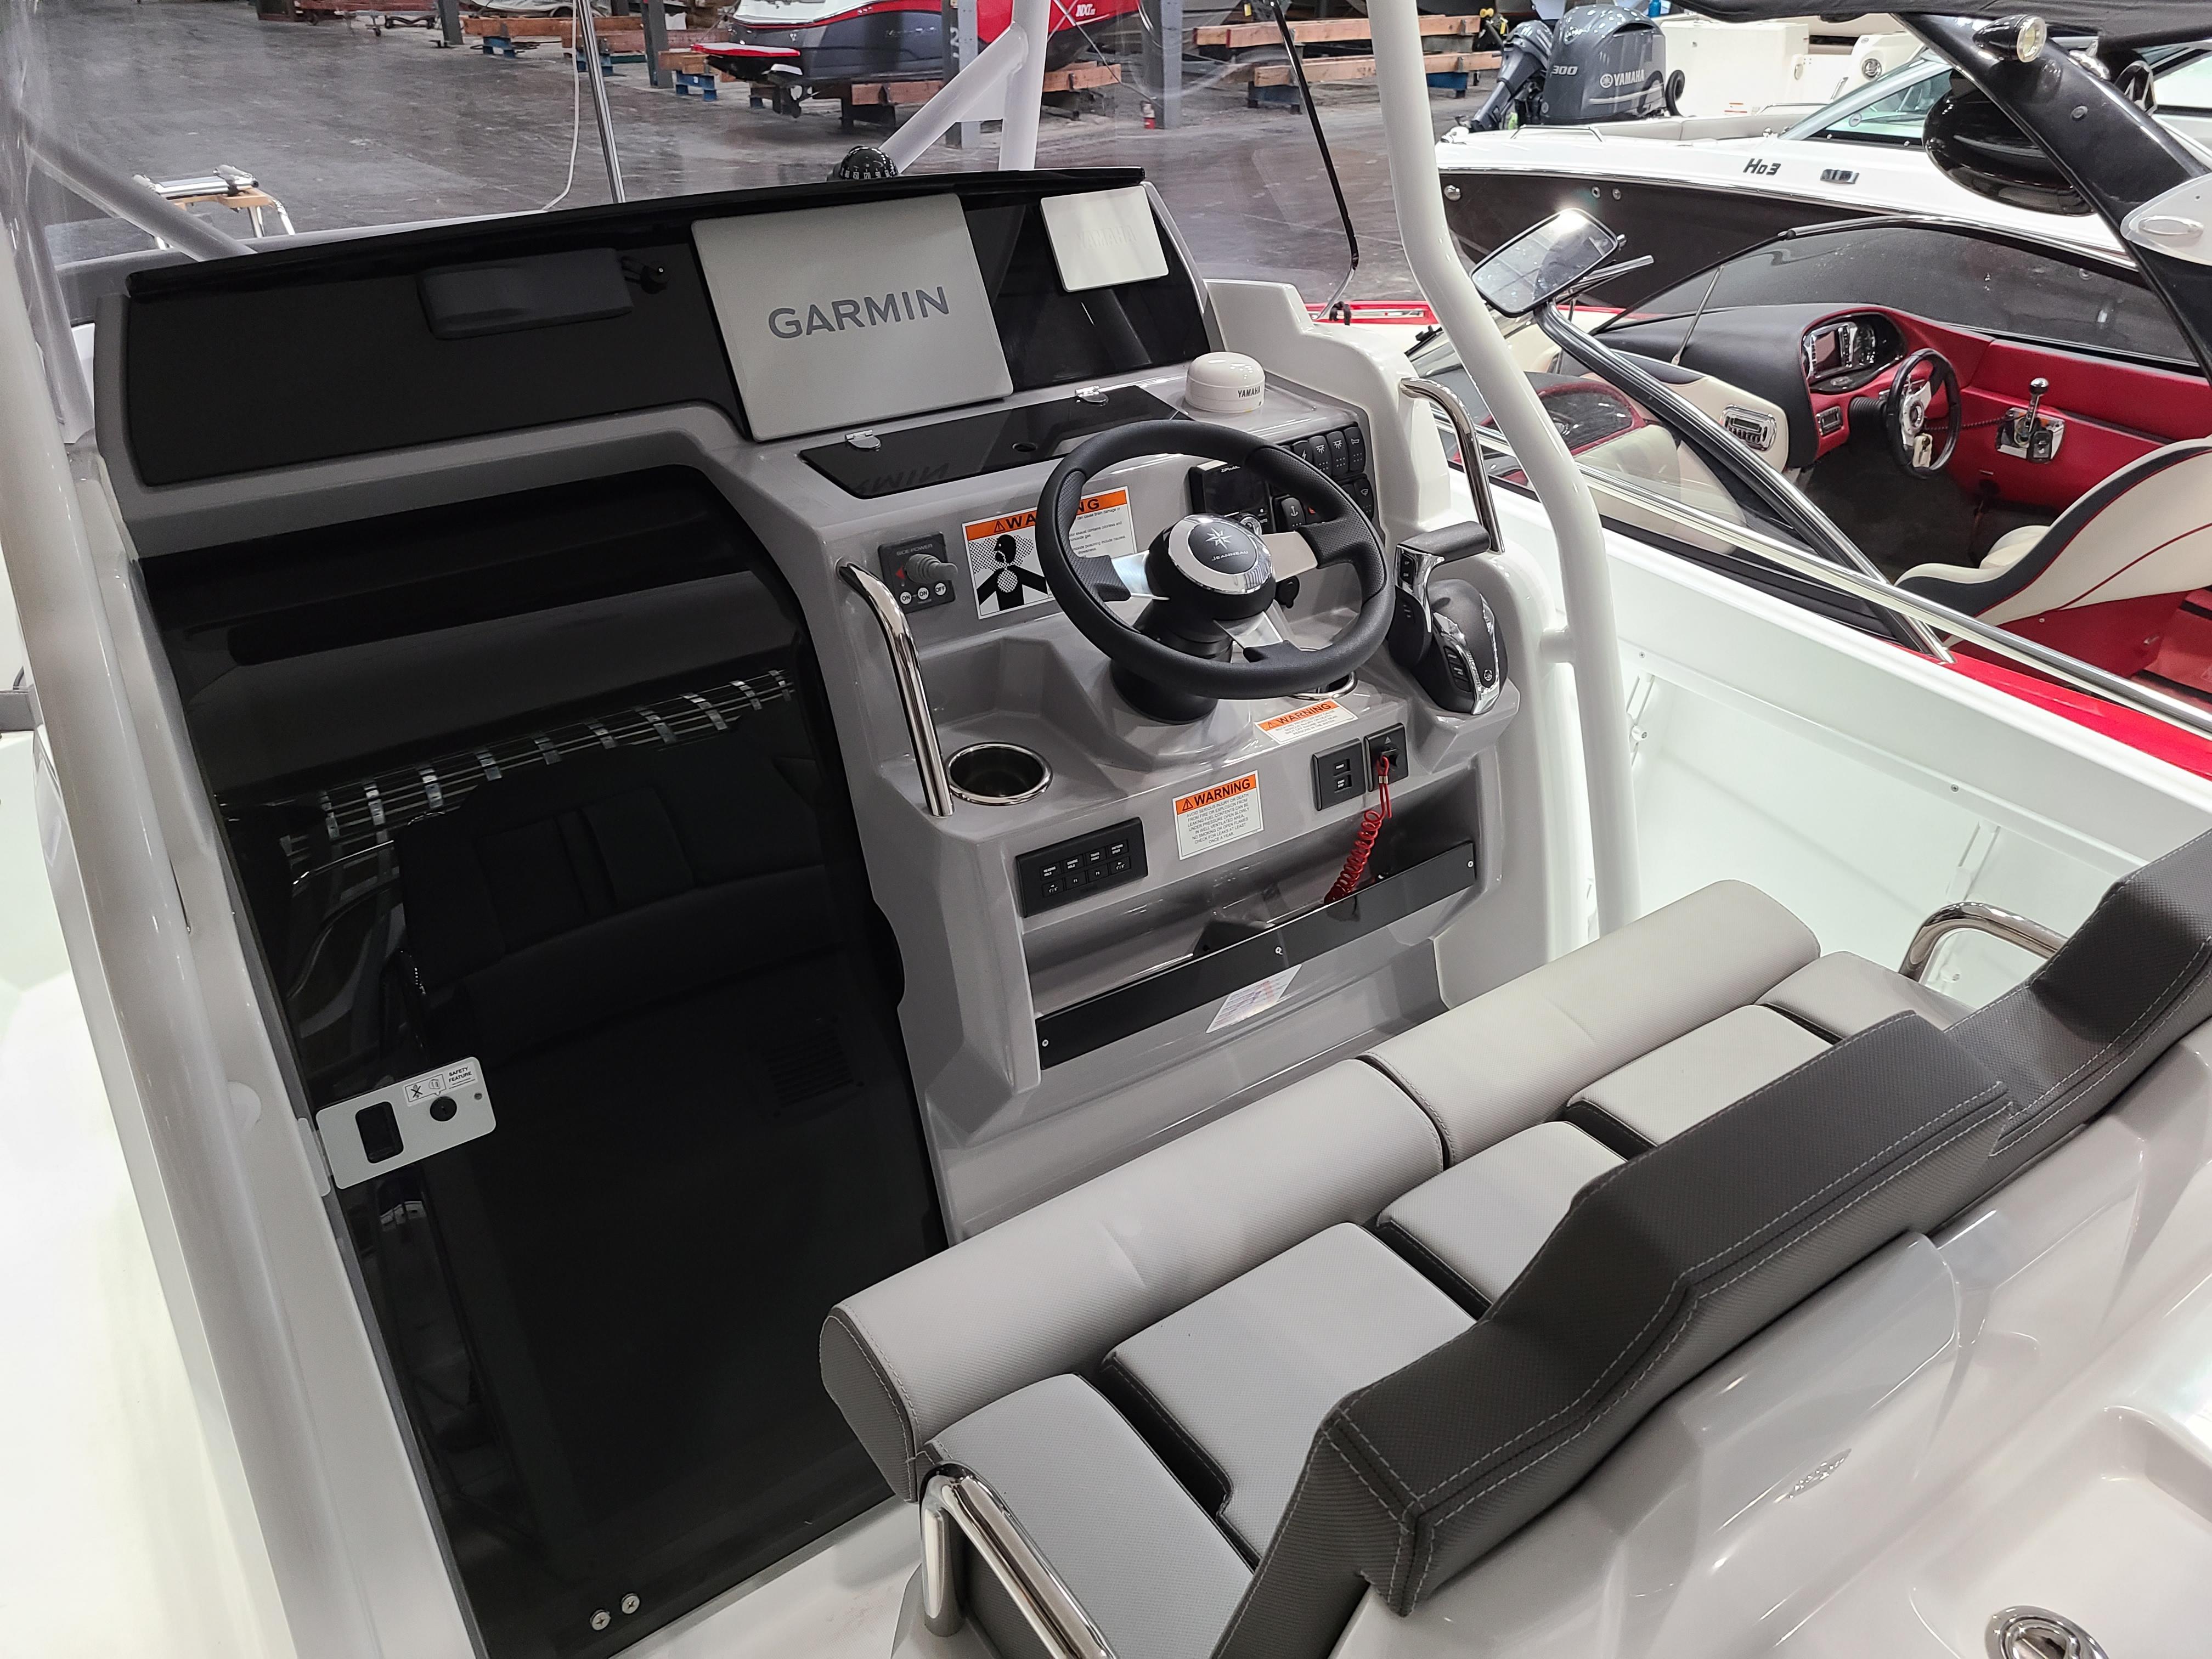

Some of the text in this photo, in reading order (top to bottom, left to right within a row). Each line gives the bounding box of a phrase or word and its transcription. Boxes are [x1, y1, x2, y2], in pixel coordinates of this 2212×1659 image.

[1551, 65, 1578, 75] 300
[1614, 69, 1645, 86] YAMAHA
[1077, 224, 1137, 249] YAMAHA
[768, 286, 950, 339] GARMIN
[1238, 386, 1260, 398] YAMAHA
[1211, 550, 1249, 561] JEANNEAU
[1277, 703, 1331, 724] WARNING
[1194, 778, 1250, 806] WARNING
[1199, 804, 1215, 813] SERIOUS
[1215, 802, 1236, 812] EXPLOSION
[1188, 819, 1204, 827] LEAKING
[1215, 808, 1234, 817] CONTENTS
[1203, 816, 1222, 827] PRESSURE
[1211, 817, 1233, 828] VENTILATED
[448, 1071, 472, 1083] FEATURE
[449, 1066, 469, 1077] SAFETY
